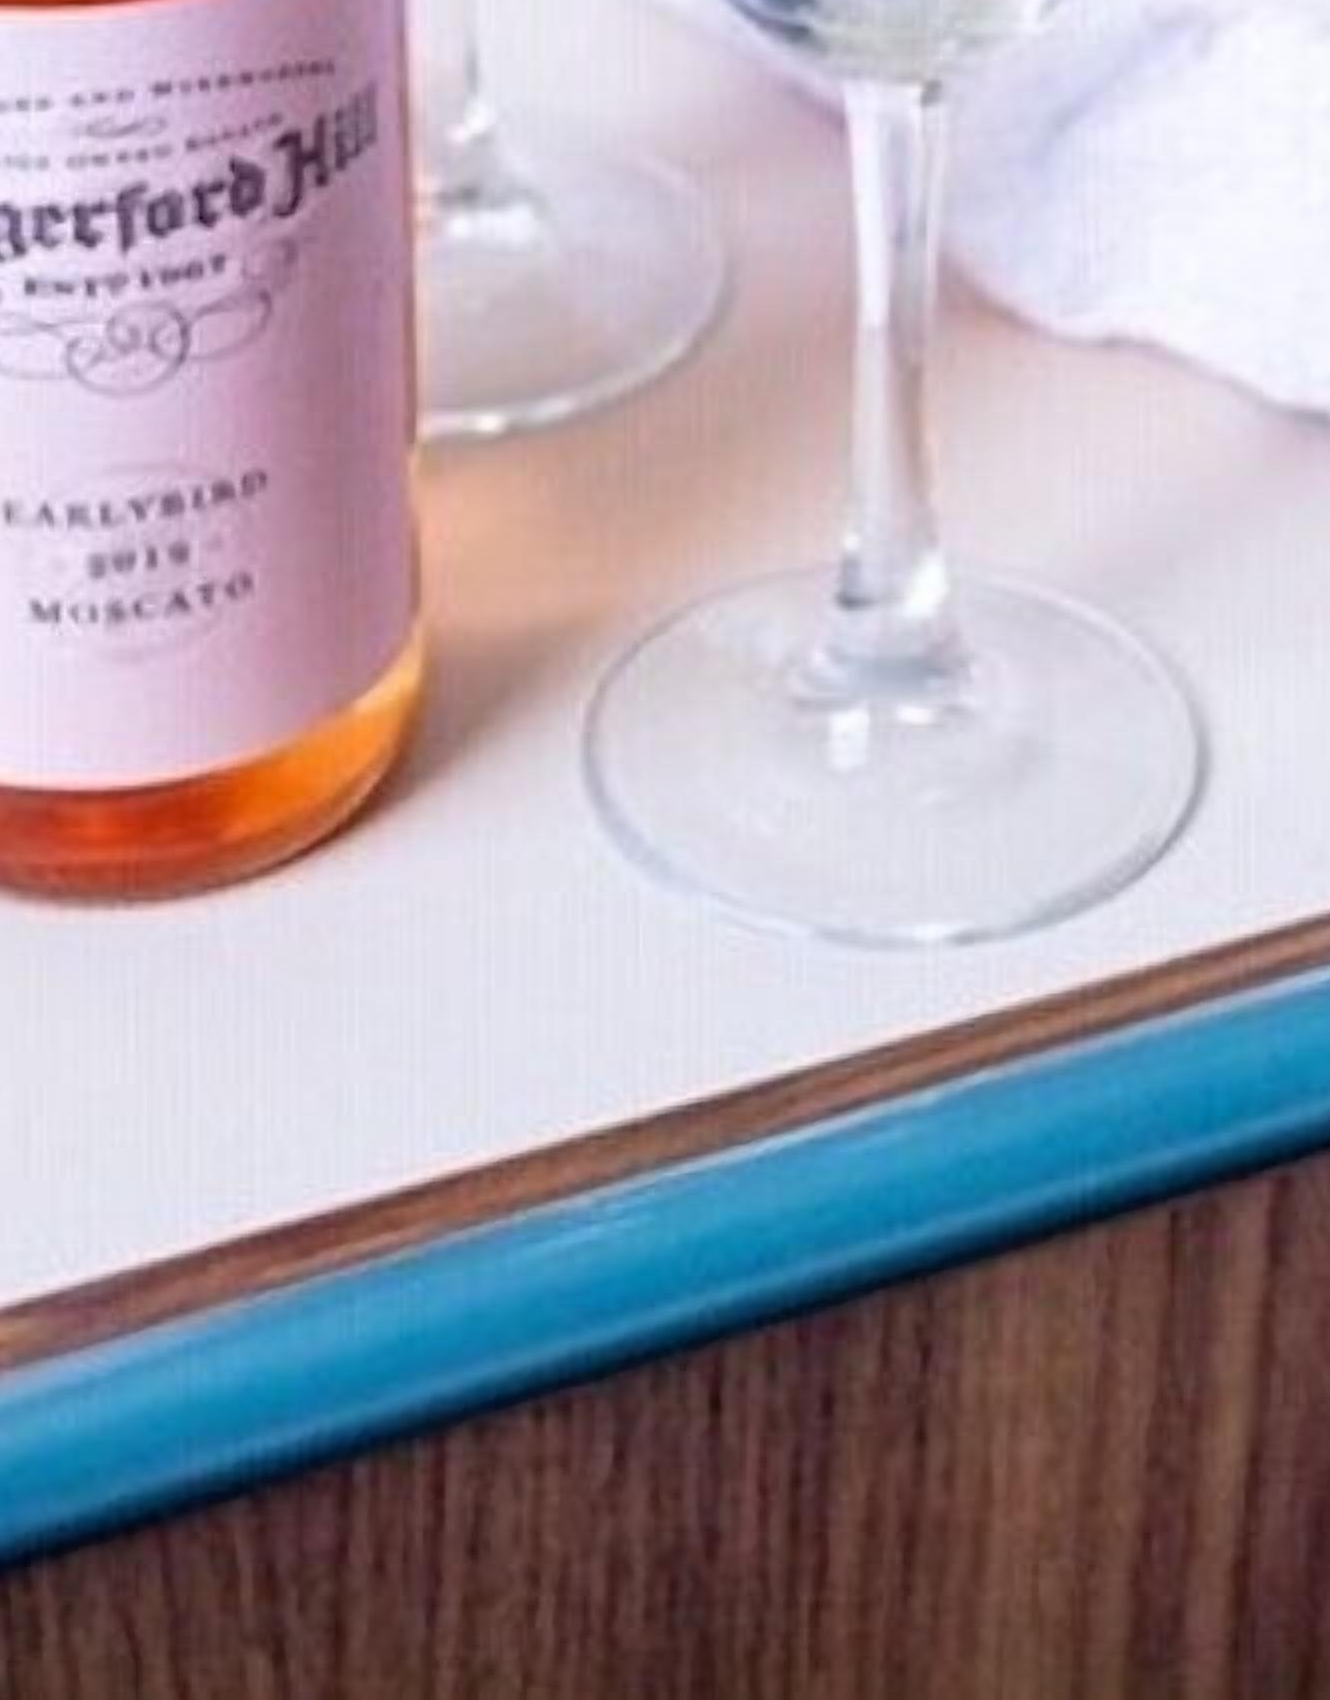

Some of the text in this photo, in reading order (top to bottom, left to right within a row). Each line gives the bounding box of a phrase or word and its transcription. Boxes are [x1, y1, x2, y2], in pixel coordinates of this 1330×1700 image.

[272, 80, 378, 219] Hill
[2, 468, 269, 529] EARLYBIRD
[29, 570, 255, 625] MOSCATO
